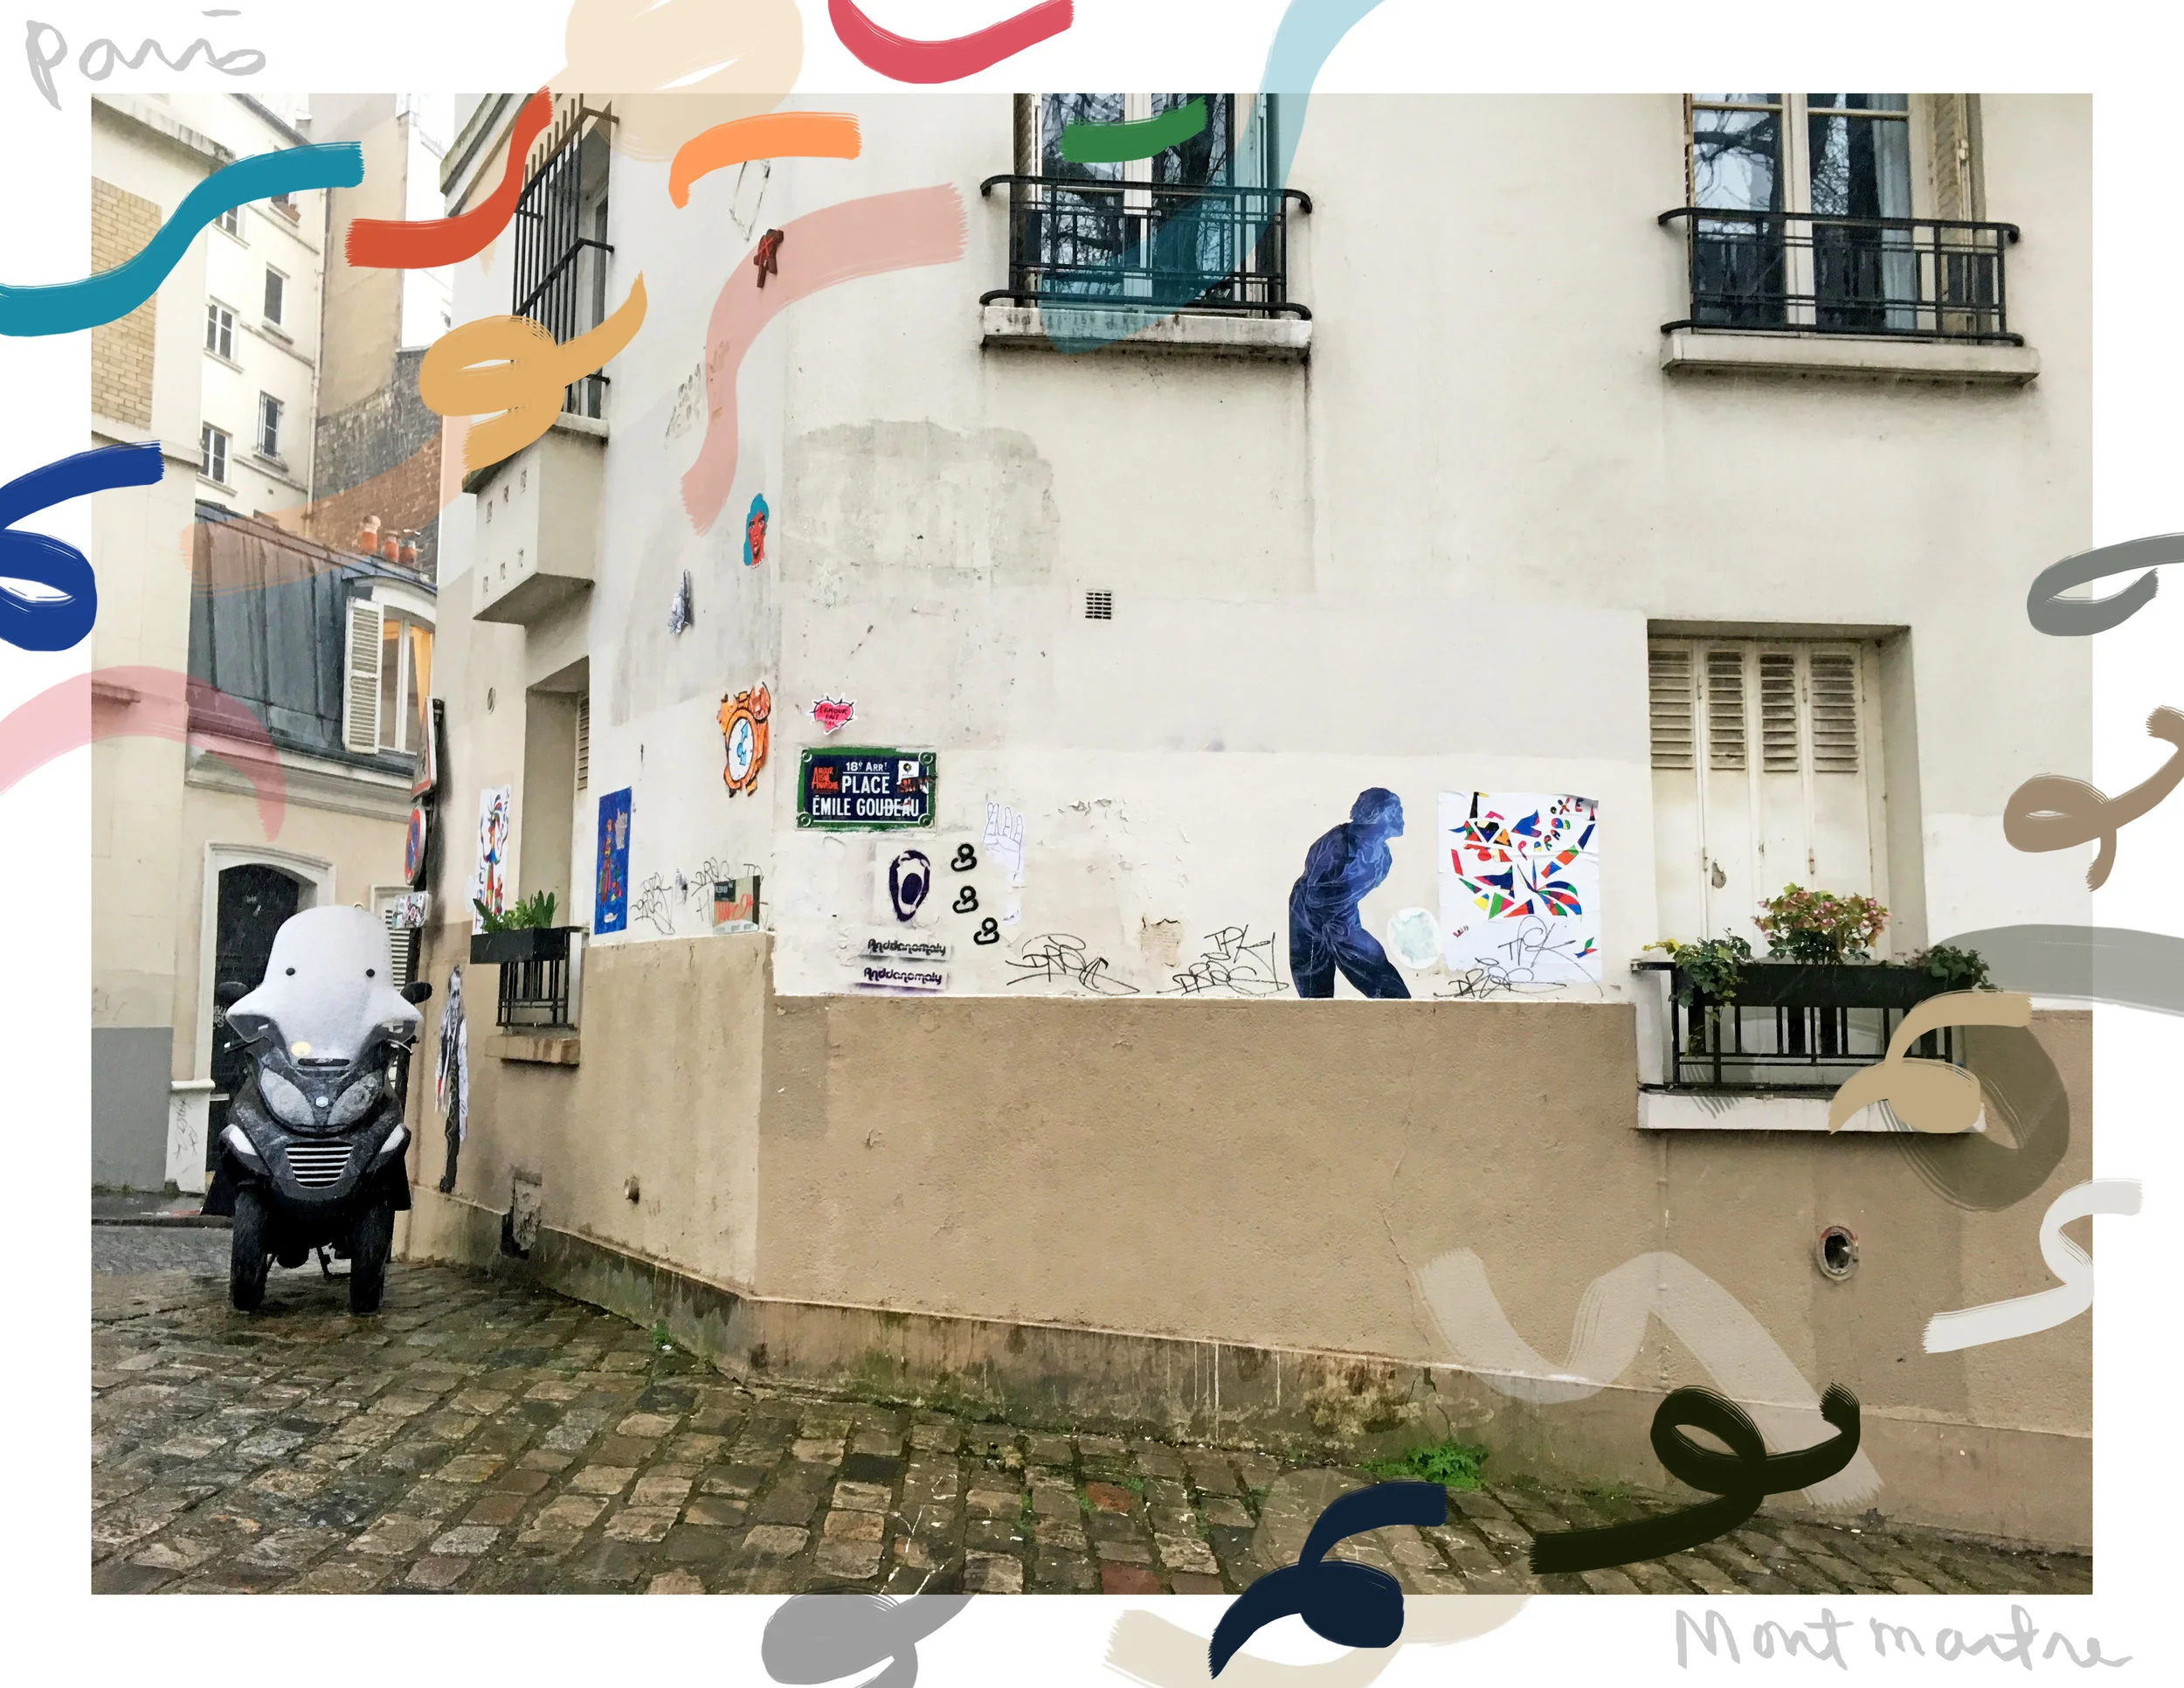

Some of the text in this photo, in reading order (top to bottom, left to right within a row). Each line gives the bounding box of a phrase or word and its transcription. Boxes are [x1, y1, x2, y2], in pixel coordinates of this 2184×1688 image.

[842, 776, 890, 793] PLACE
[812, 795, 919, 816] ÉMILE GOUDEAU
